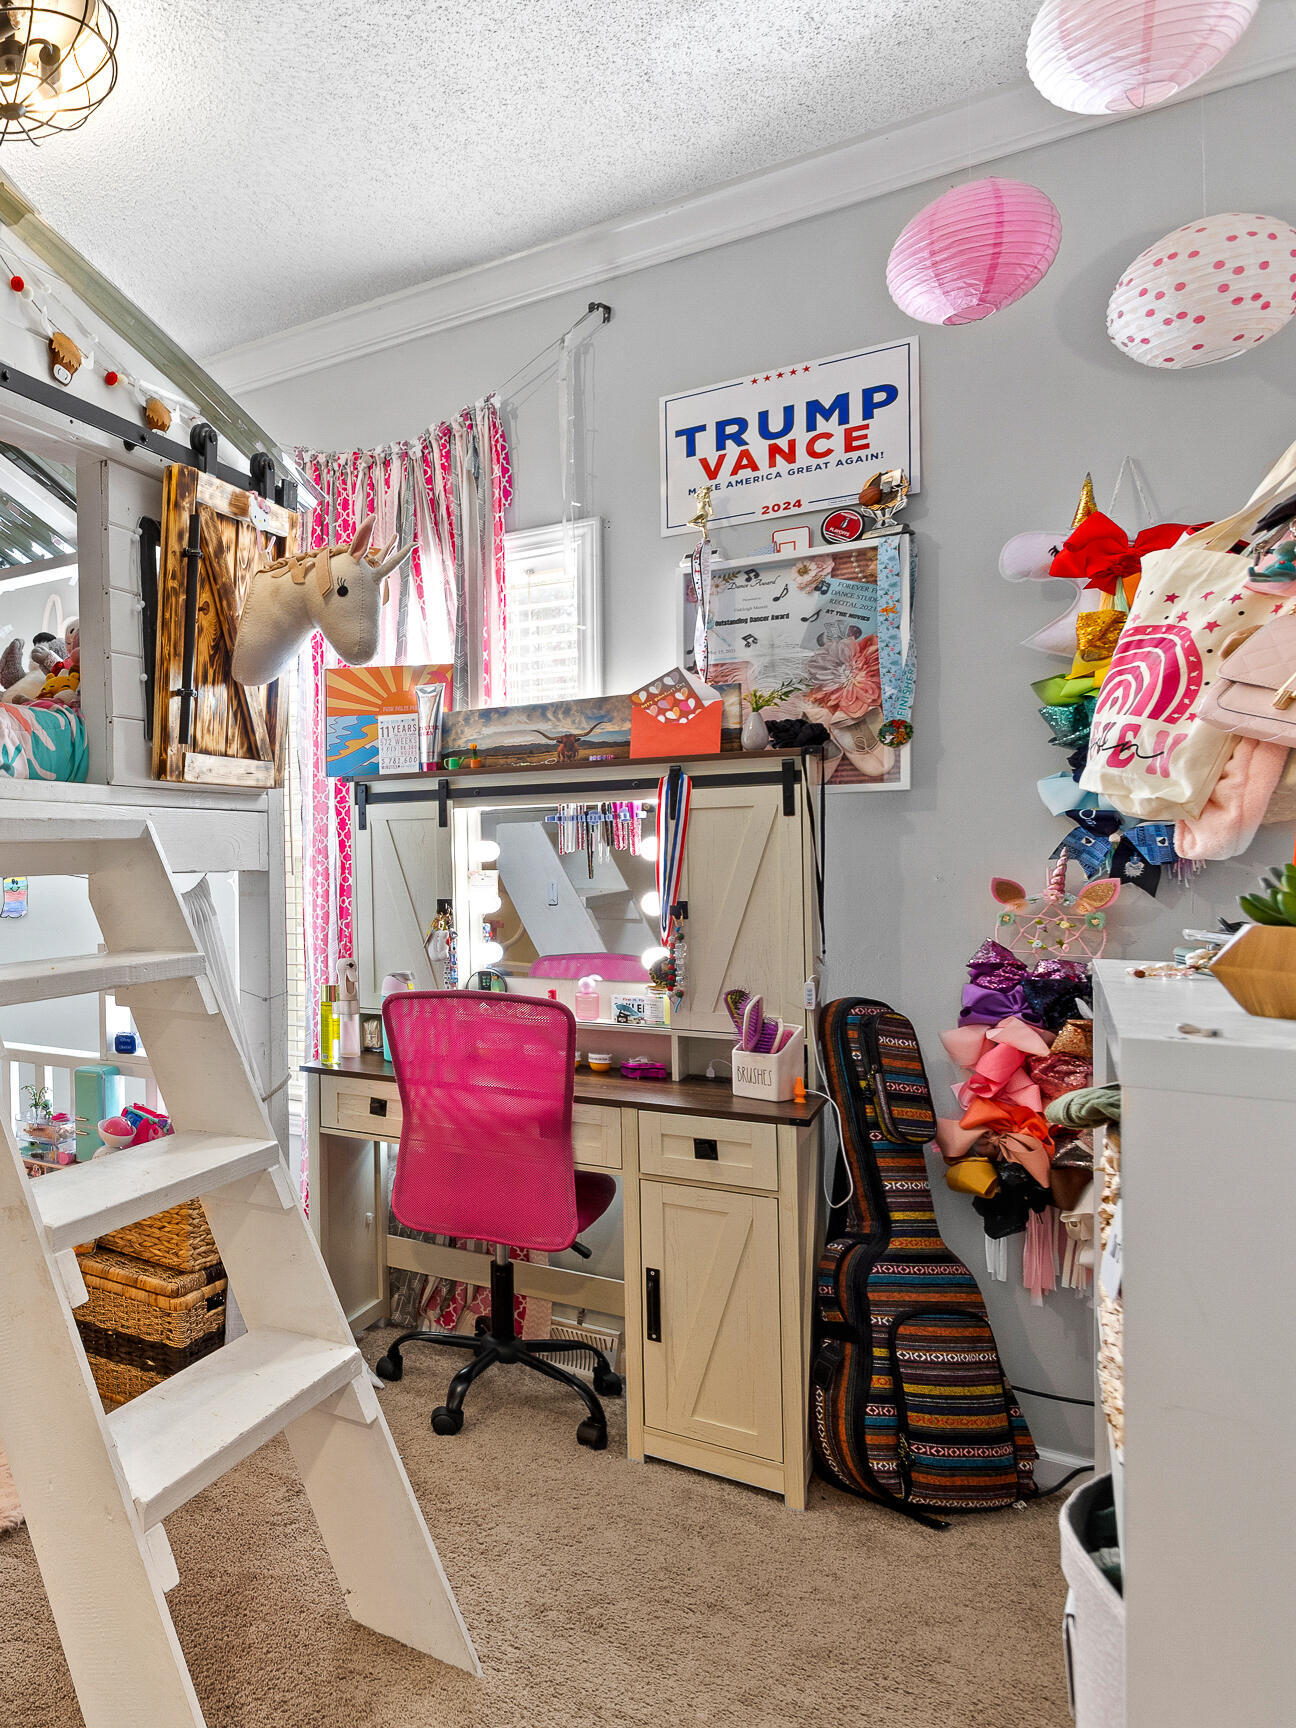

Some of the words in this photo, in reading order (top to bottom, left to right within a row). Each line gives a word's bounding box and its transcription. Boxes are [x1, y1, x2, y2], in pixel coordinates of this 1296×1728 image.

[675, 384, 899, 458] TRUMP
[699, 423, 871, 481] VANCE
[688, 483, 722, 496] ME
[726, 472, 782, 488] AMERICA
[788, 462, 830, 476] GREAT
[835, 451, 885, 467] AGAIN!
[761, 499, 803, 515] 2024
[727, 581, 749, 590] Dance
[750, 575, 782, 588] Award
[837, 581, 870, 592] FOREVER
[831, 590, 855, 599] DANCE
[829, 599, 858, 608] RECITAL
[714, 617, 748, 627] Outstanding
[749, 615, 770, 623] Dancer
[771, 613, 790, 621] Award
[897, 668, 914, 716] FINISHER
[380, 726, 390, 738] 11
[392, 724, 417, 733] YEARS
[395, 737, 417, 745] WEEKS
[737, 1066, 773, 1087] BRUSHES
